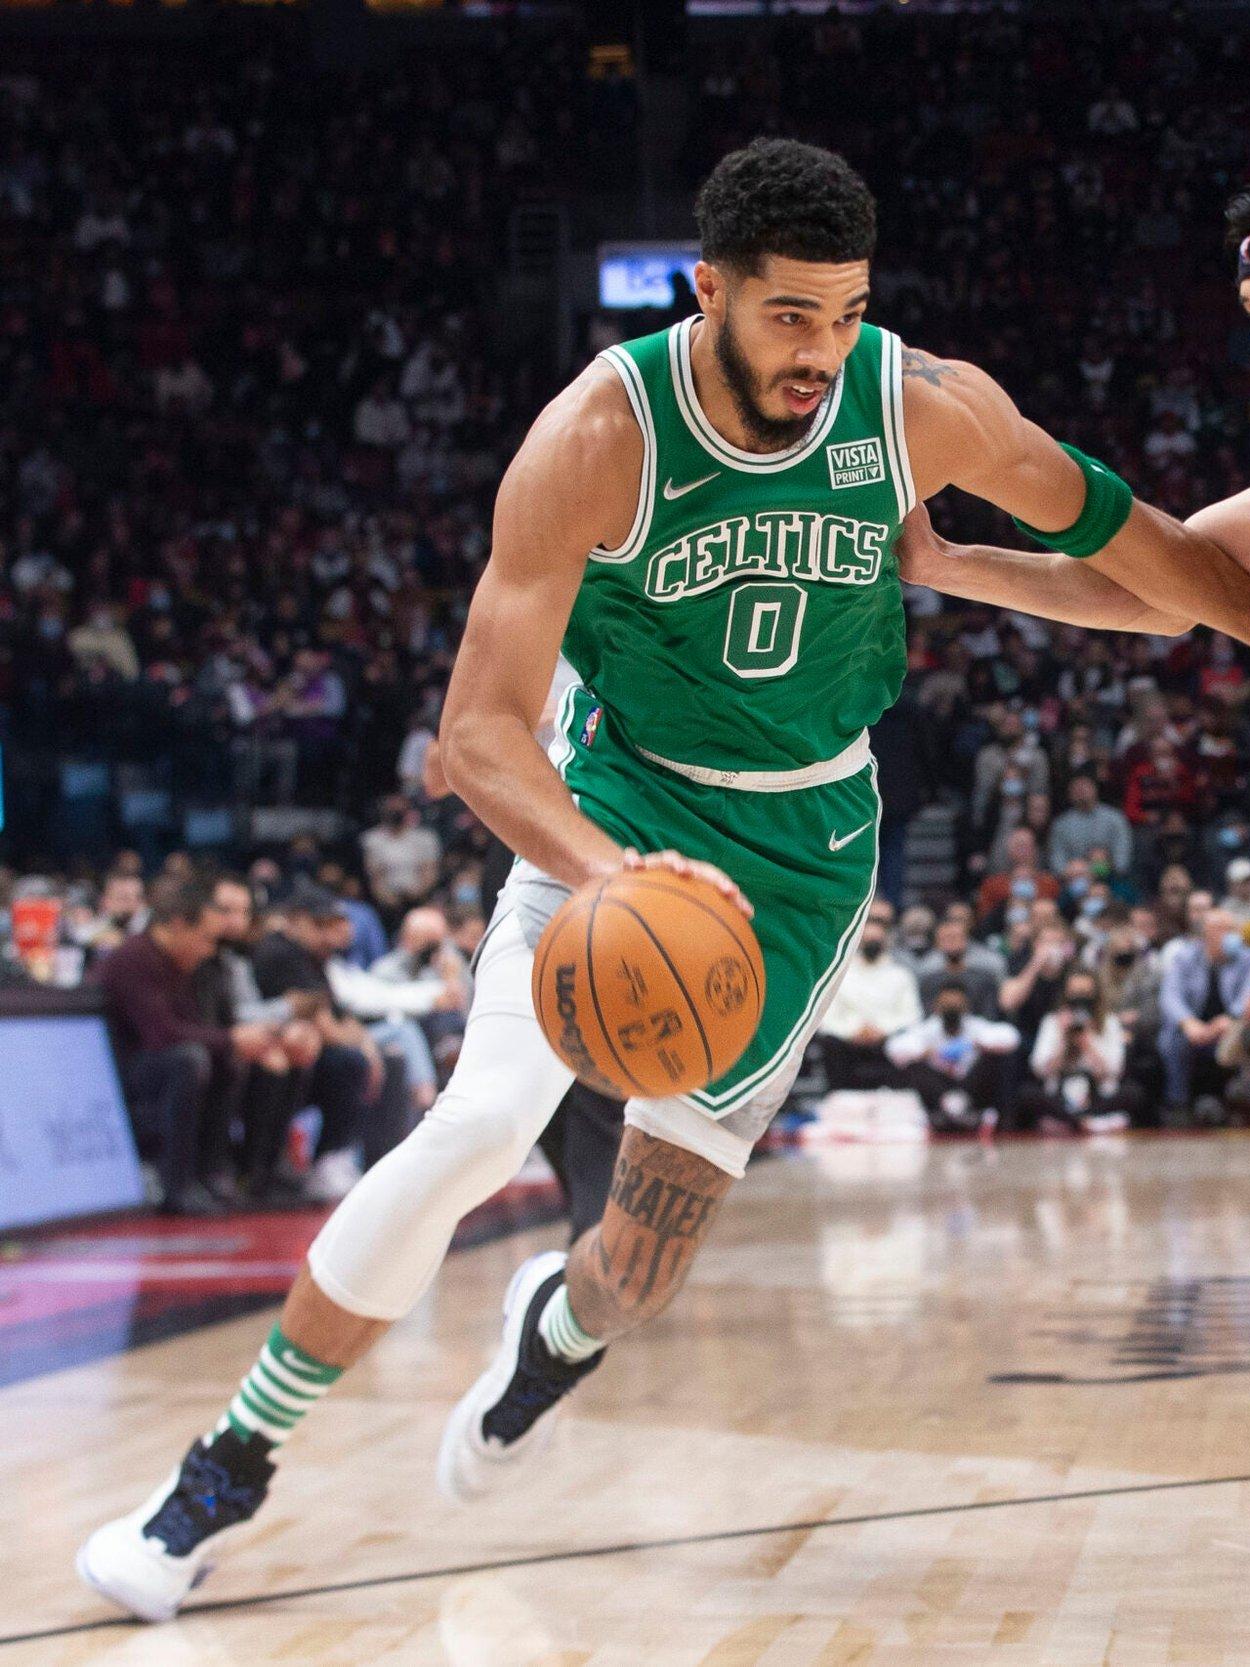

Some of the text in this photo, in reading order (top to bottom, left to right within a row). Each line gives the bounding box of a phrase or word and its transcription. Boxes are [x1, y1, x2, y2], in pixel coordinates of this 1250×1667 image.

[832, 444, 878, 468] VISTA
[835, 469, 864, 485] PRINT
[644, 511, 888, 603] CELTICS
[723, 583, 809, 679] 0
